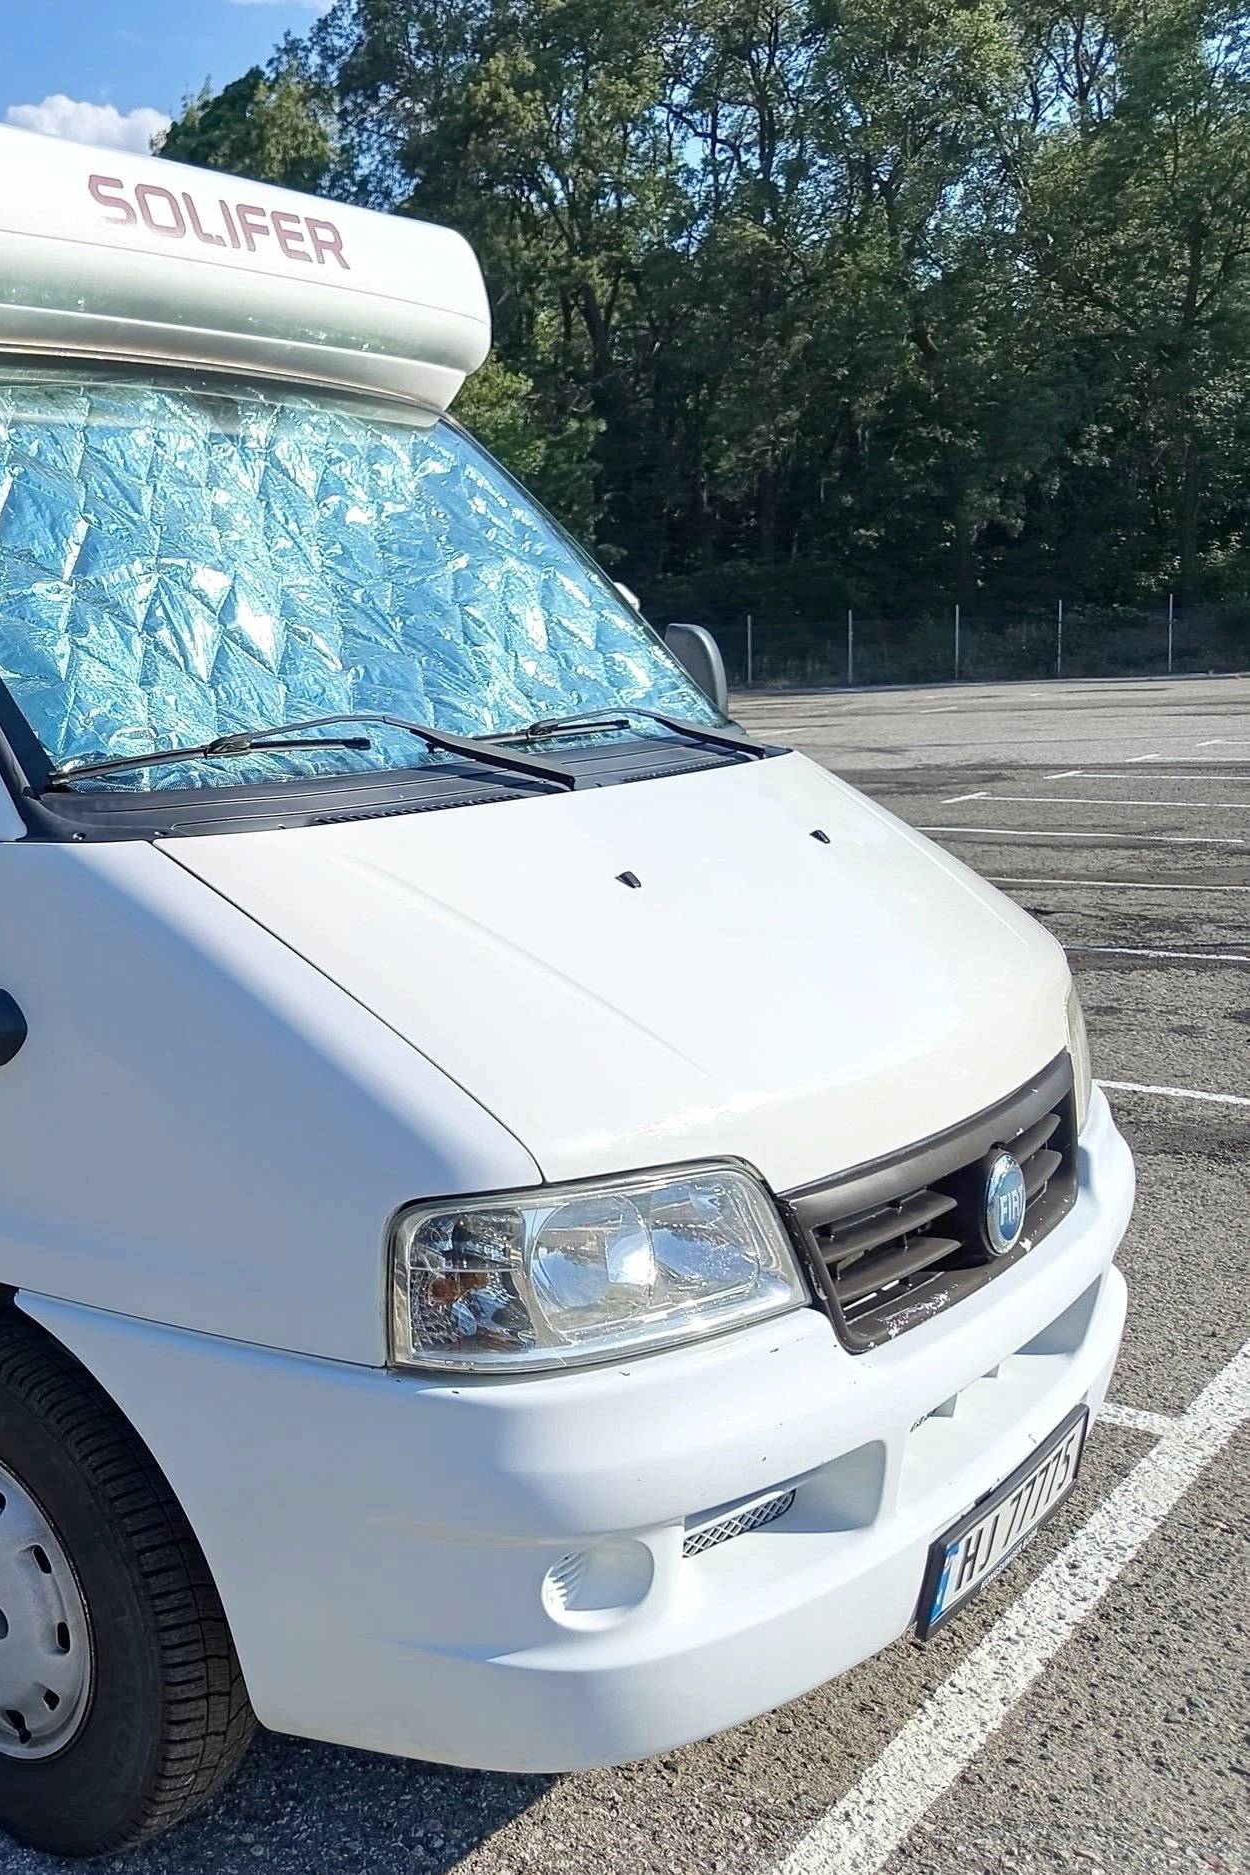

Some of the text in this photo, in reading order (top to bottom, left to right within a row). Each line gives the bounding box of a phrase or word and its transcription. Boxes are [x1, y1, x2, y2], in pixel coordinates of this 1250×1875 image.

[88, 174, 350, 270] SOLIFER
[999, 1184, 1024, 1226] FIAT
[955, 1433, 1076, 1592] HJ 77775
